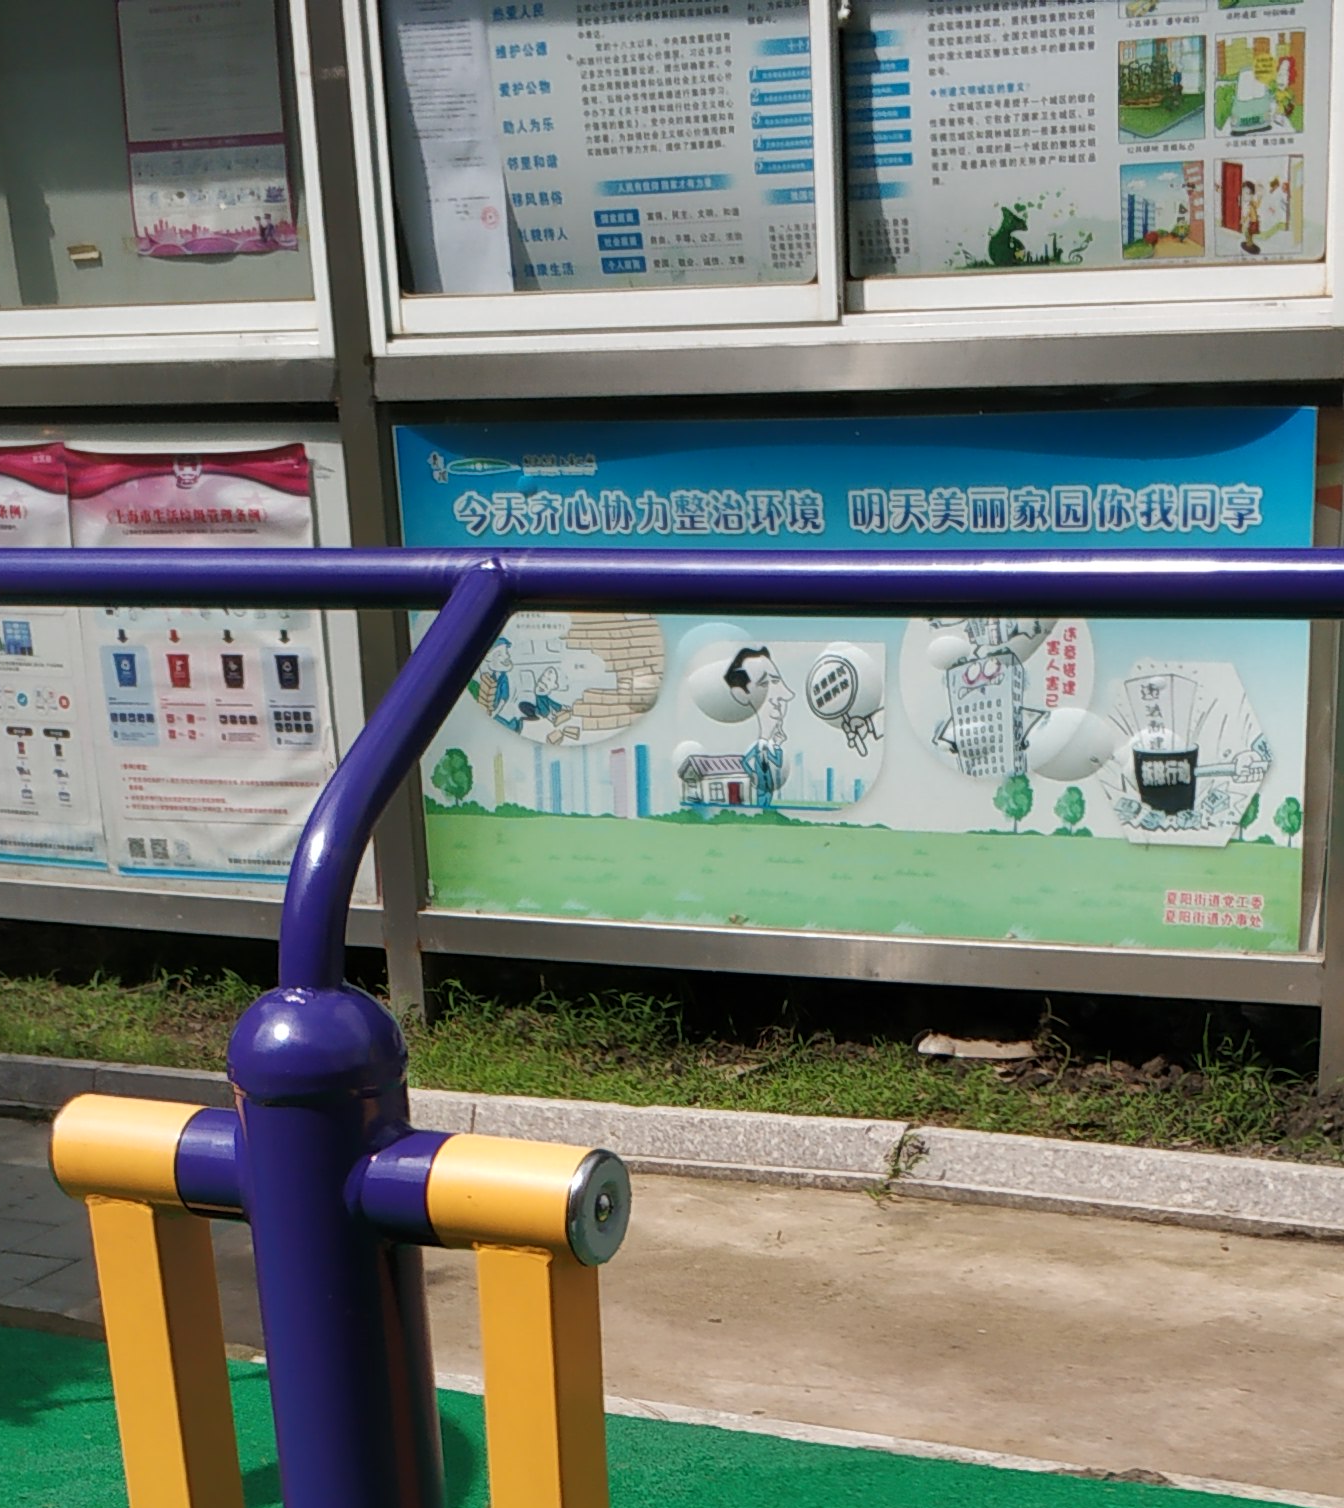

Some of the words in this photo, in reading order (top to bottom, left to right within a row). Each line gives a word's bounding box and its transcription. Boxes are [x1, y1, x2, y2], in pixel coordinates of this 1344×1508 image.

[502, 117, 555, 135] 助人为乐
[506, 155, 559, 171] 邻里和谐
[511, 191, 564, 208] 移风易俗
[454, 490, 826, 536] 今天齐心协力整治环境
[847, 484, 1264, 535] 明天美丽家园你我同享
